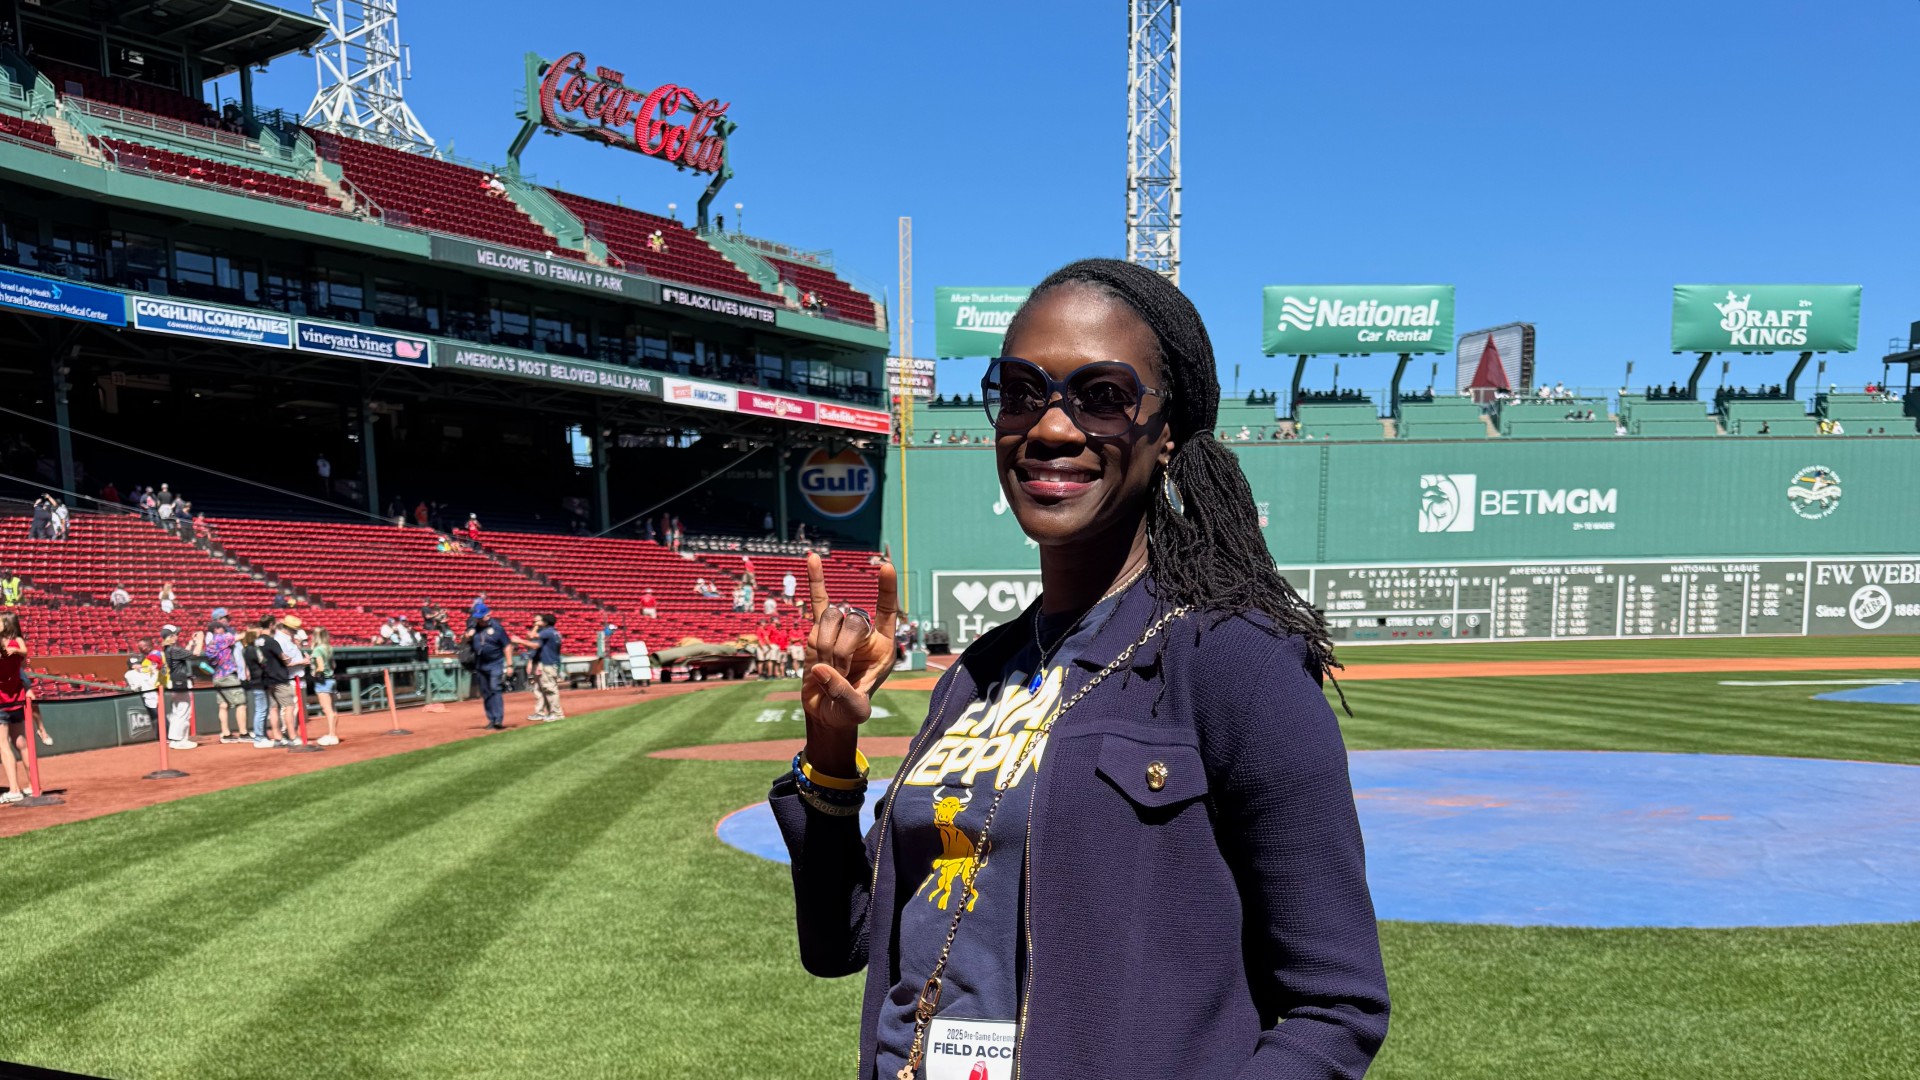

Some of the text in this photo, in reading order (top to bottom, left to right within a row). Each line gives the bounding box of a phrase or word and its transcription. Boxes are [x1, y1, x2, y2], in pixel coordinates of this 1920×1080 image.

[477, 249, 623, 292] WELCOME TO FENWAY PARK
[5, 293, 23, 305] Israel
[24, 296, 60, 312] Deaconess
[60, 303, 86, 317] Medical
[86, 308, 108, 320] Center
[137, 301, 288, 335] COGHLIN COMPANIES
[679, 292, 774, 323] BLACK LIVES MATTER
[1720, 308, 1813, 332] DRAFT
[301, 328, 359, 350] vineyard
[359, 336, 393, 354] vines
[1357, 328, 1433, 342] Car Rental
[1730, 328, 1808, 346] KINGS
[455, 351, 516, 372] AMERICA'S
[518, 360, 548, 377] MOST
[550, 365, 597, 384] BELOVED
[600, 372, 651, 393] BALLPARK
[801, 469, 869, 491] Gulf
[1480, 488, 1618, 515] BETMGM
[1348, 568, 1458, 579] FENWAY PARK
[1509, 566, 1604, 575] AMERICAN LEAGUE
[1670, 563, 1760, 573] NATIONAL LEAGUE
[988, 581, 1043, 612] CV
[1815, 604, 1847, 617] Since
[947, 1028, 964, 1040] 2025
[964, 1030, 991, 1041] Pre-Game
[934, 1042, 973, 1056] FIELD
